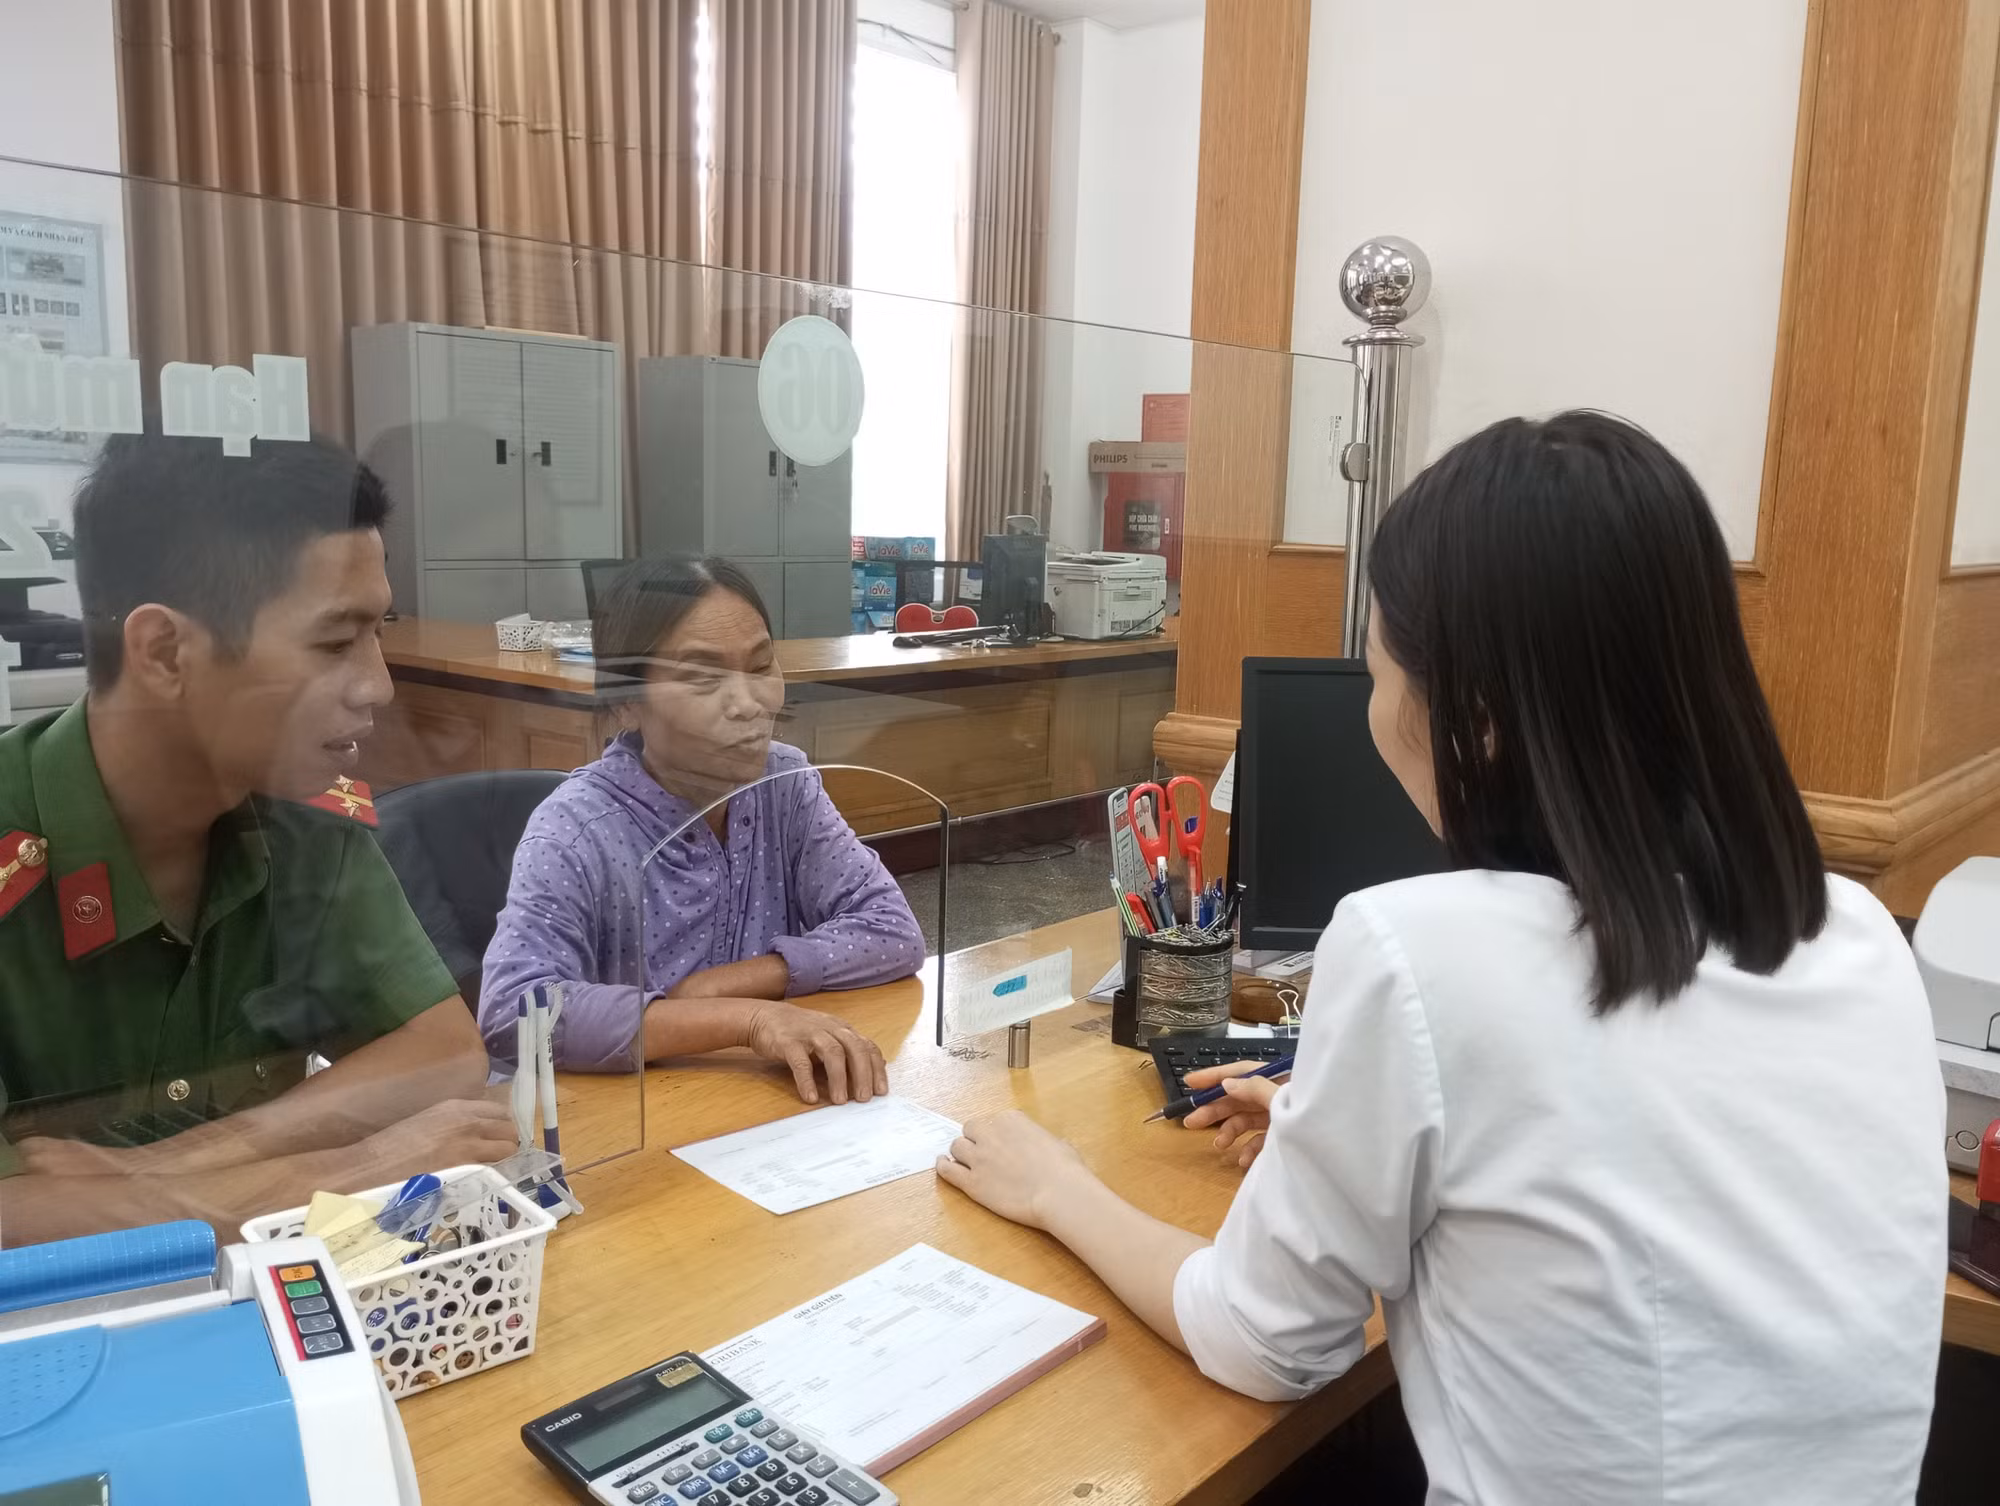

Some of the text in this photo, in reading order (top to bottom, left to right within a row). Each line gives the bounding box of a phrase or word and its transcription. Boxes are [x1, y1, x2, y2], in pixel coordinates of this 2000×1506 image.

[1093, 454, 1128, 464] PHILIPS
[711, 1339, 762, 1365] GRIBANK
[545, 1412, 582, 1432] CASIO
